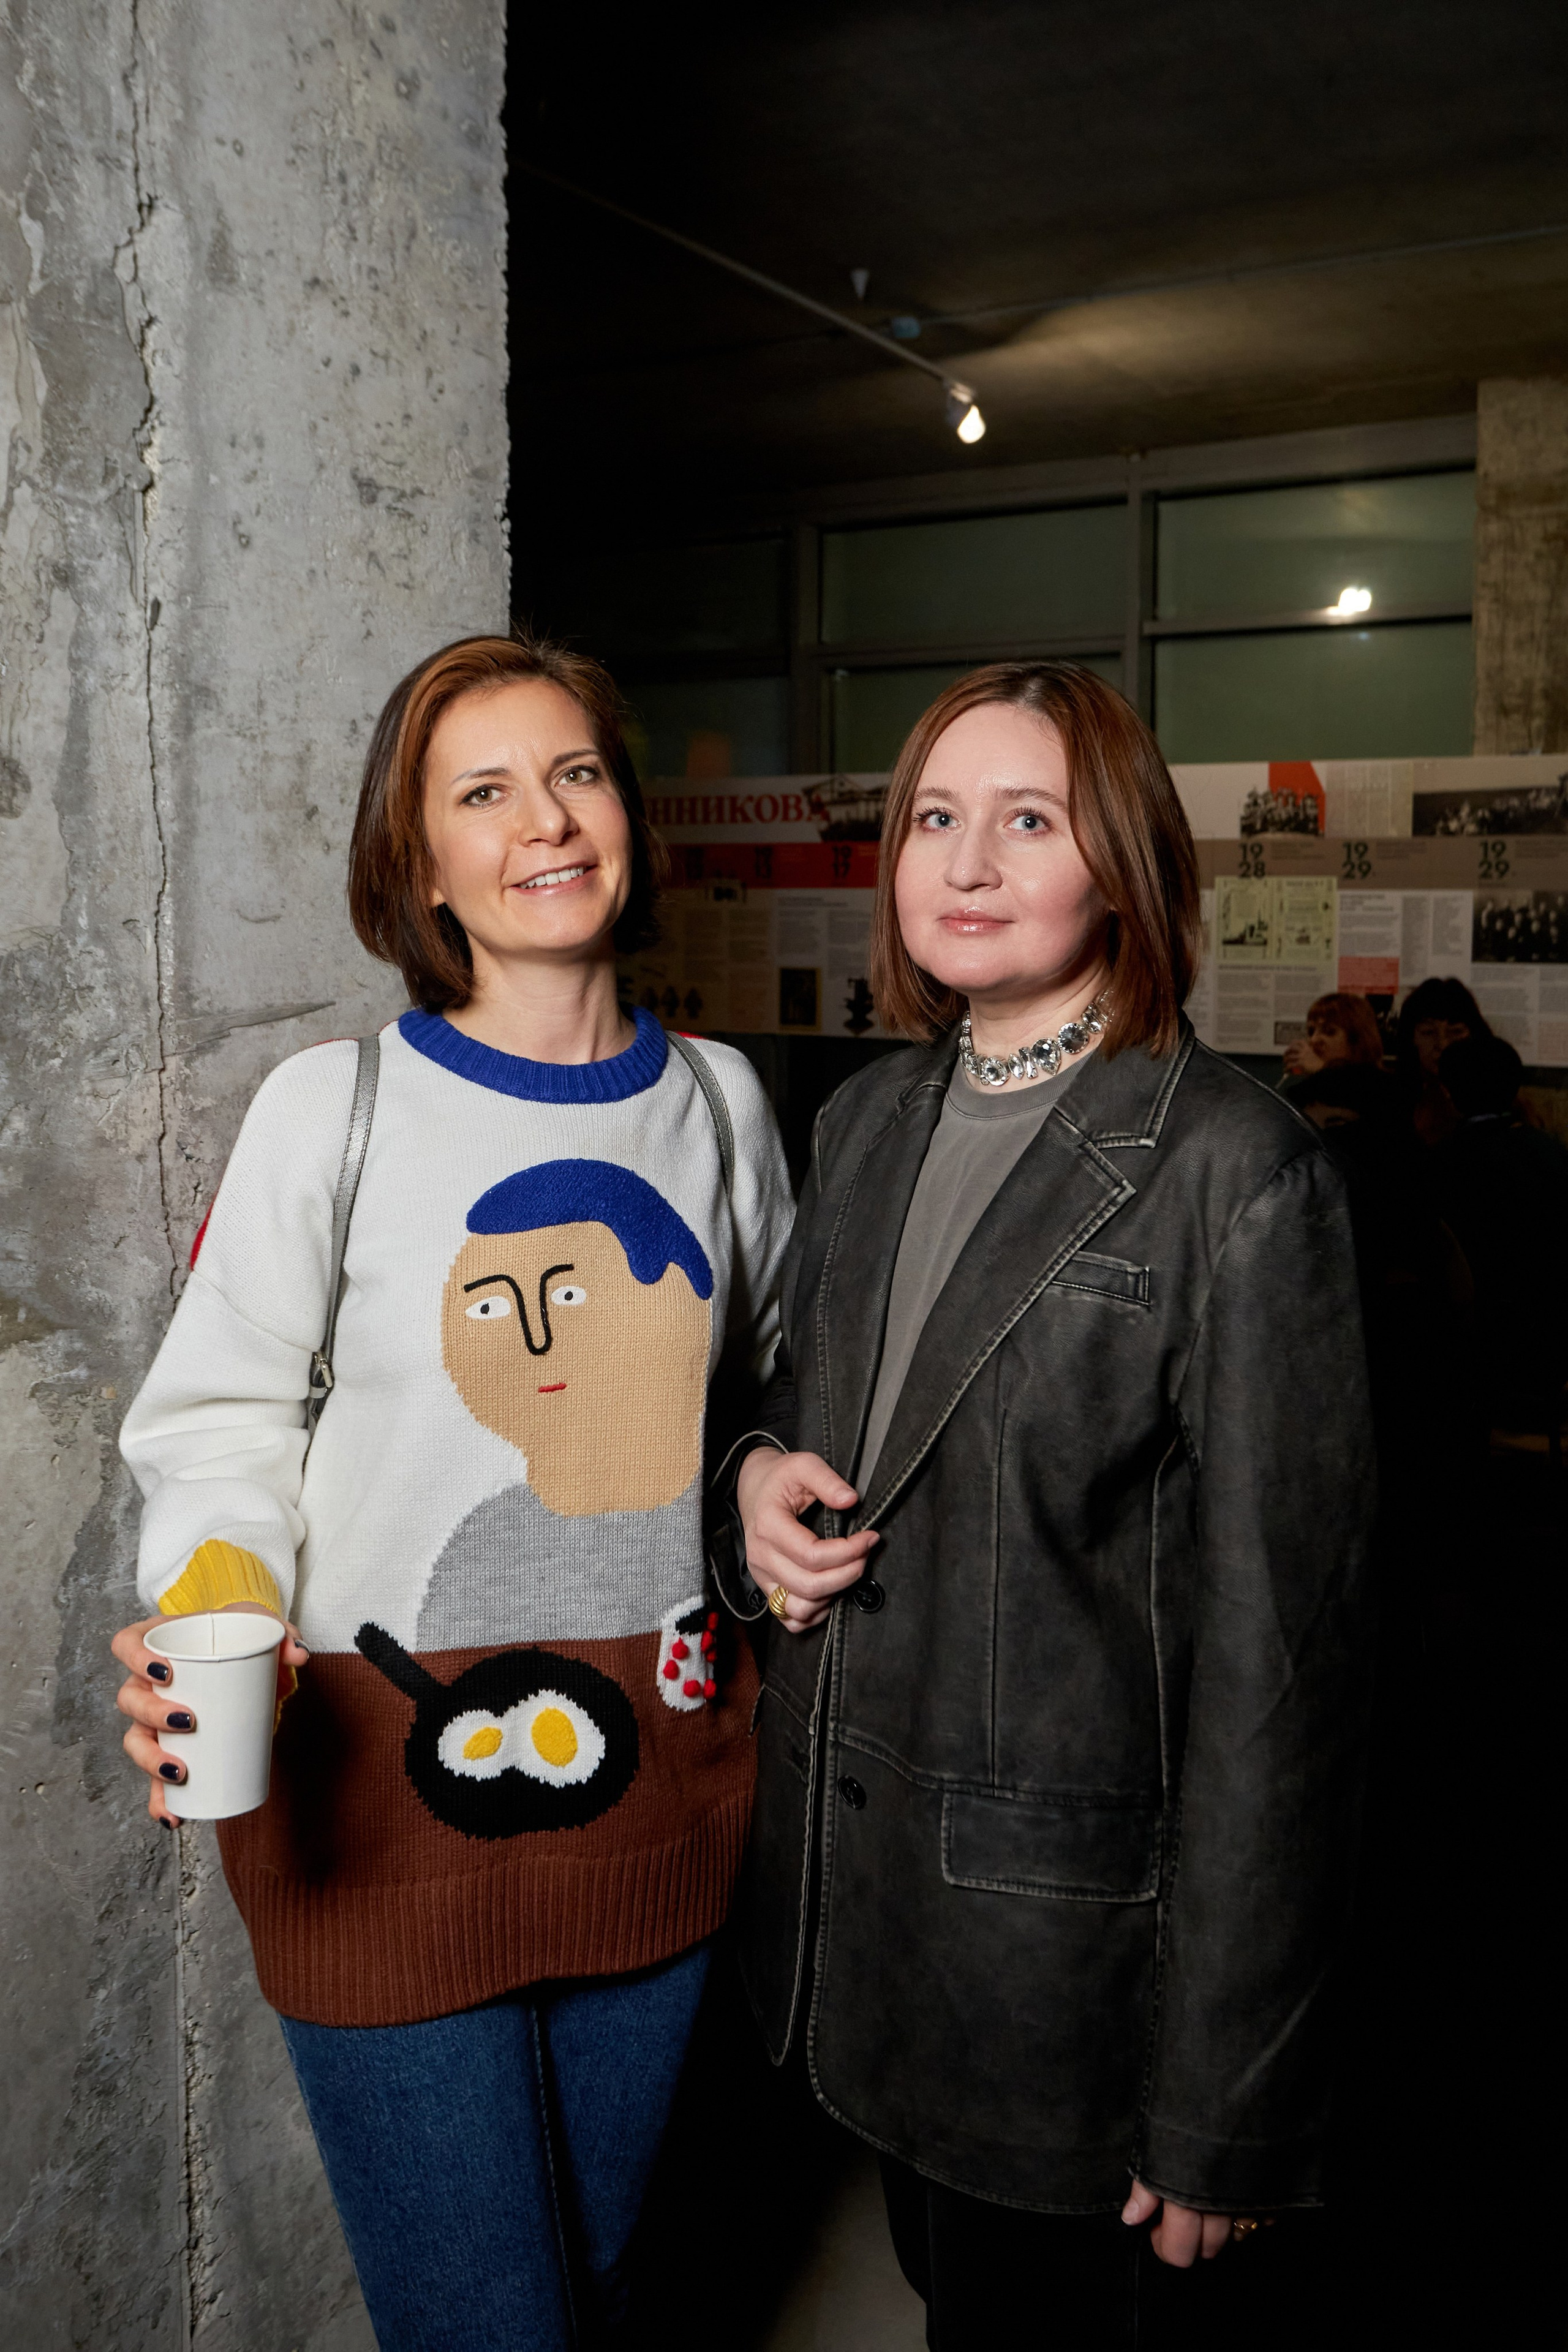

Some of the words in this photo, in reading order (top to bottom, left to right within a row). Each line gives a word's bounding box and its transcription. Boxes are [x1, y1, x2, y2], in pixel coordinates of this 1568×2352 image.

[646, 793, 831, 825] ННИКОВА
[832, 845, 853, 862] 19
[1238, 842, 1264, 860] 19
[1343, 842, 1368, 859] 19
[1479, 840, 1507, 859] 19
[831, 862, 852, 879] 17
[1238, 861, 1266, 879] 28
[1342, 860, 1372, 879] 29
[1479, 860, 1510, 879] 29
